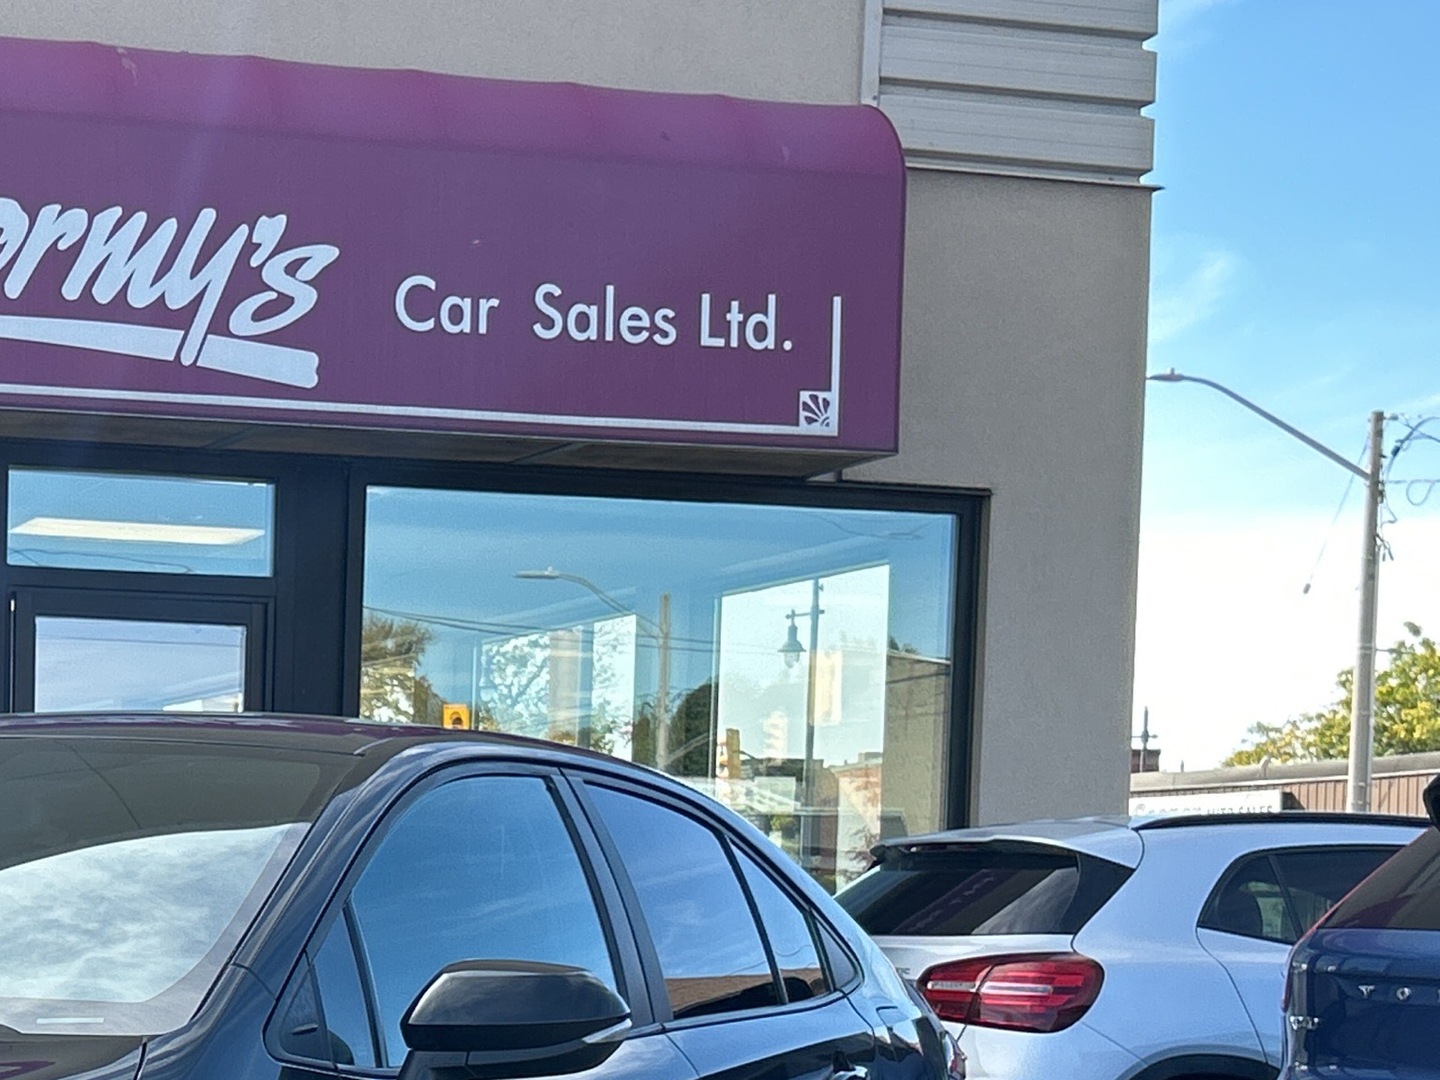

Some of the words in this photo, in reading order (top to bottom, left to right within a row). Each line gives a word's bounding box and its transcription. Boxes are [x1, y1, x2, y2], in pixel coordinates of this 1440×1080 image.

[394, 274, 500, 335] Car
[532, 283, 677, 347] Sales
[700, 292, 794, 352] Ltd.
